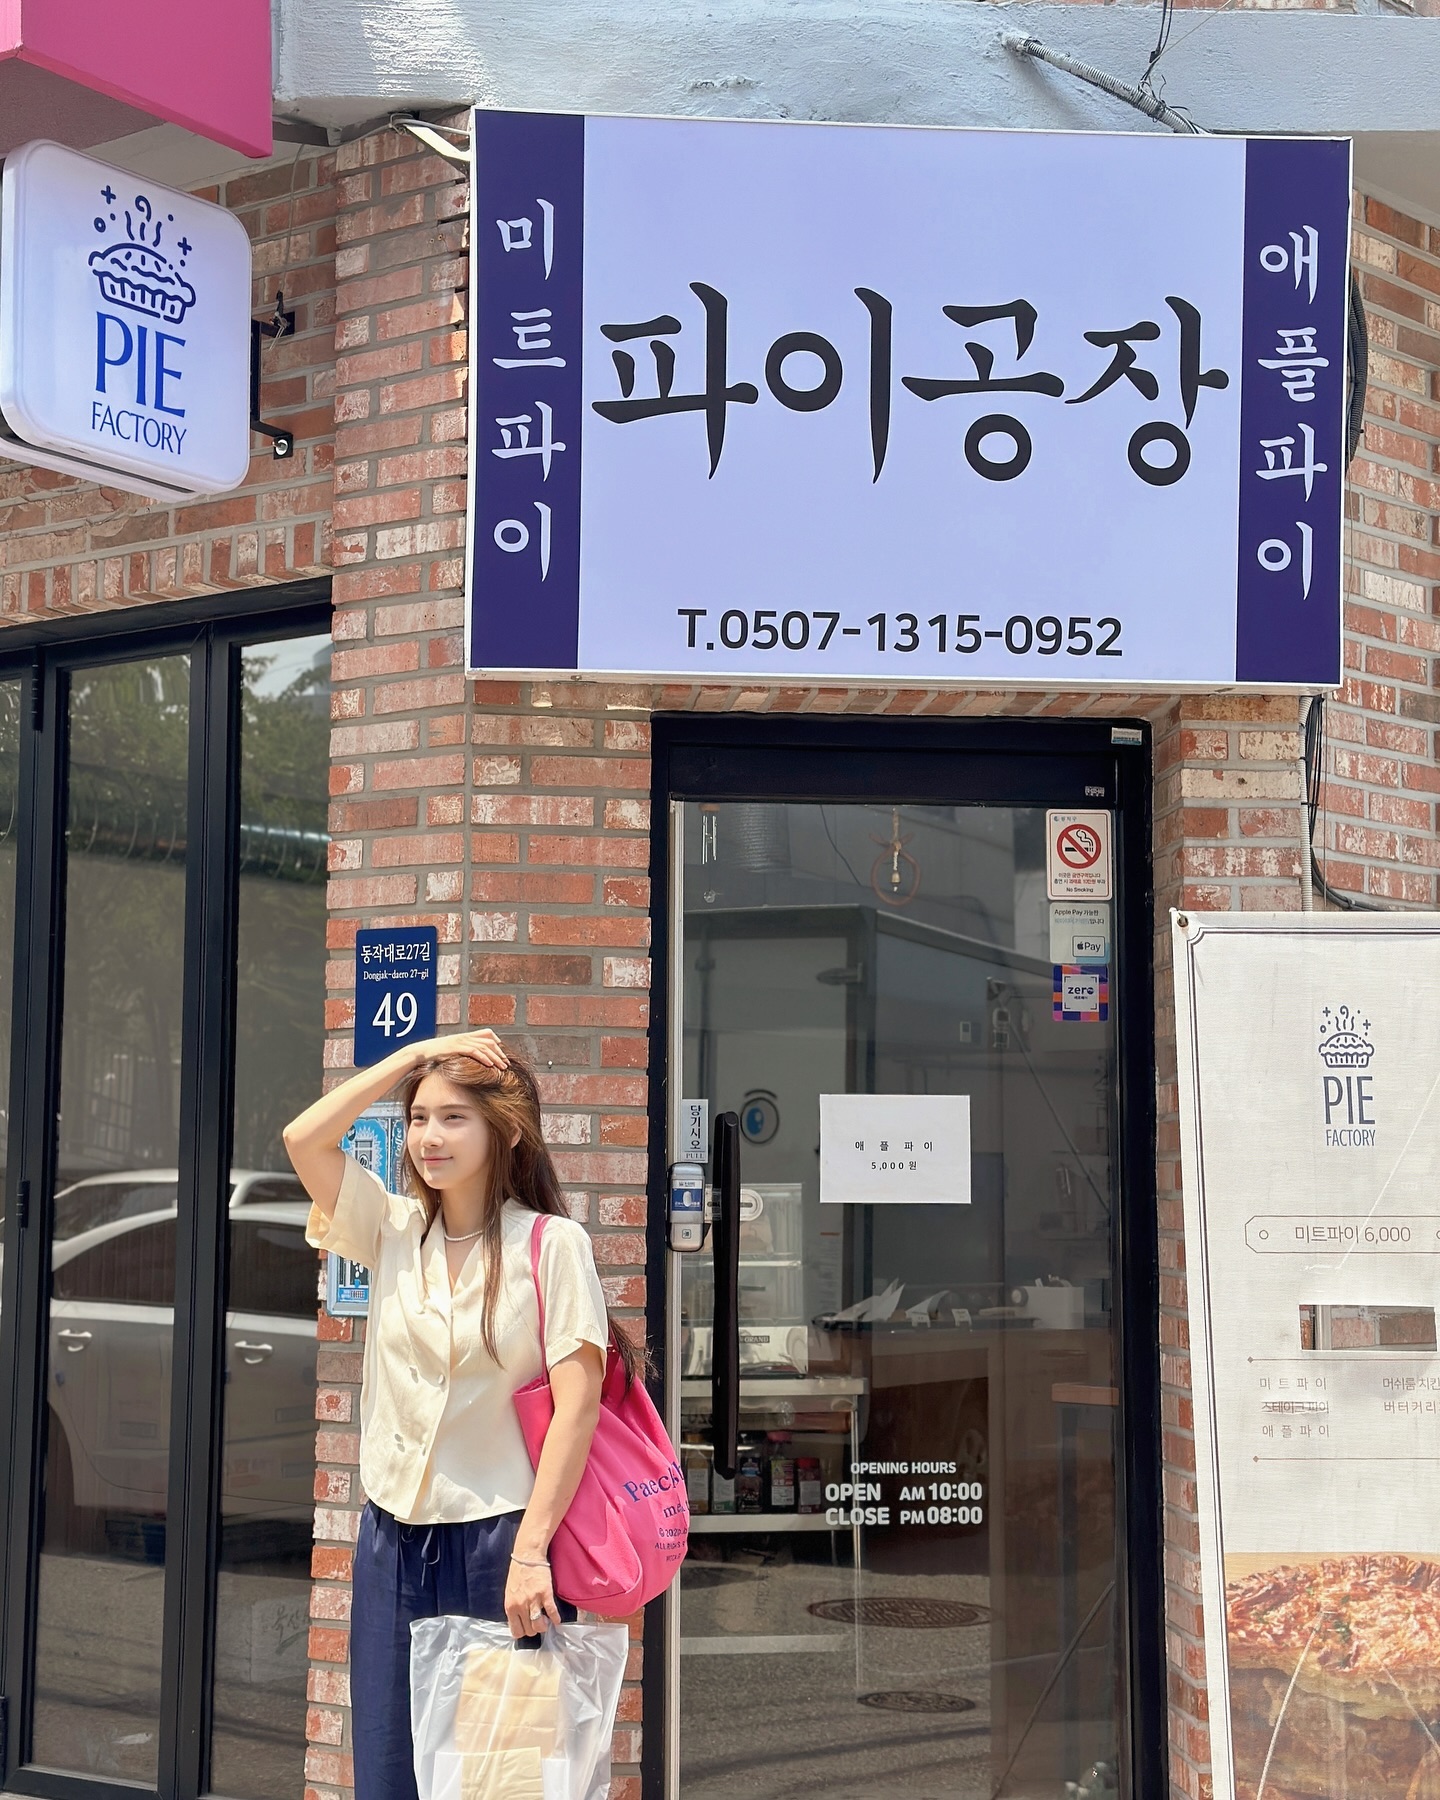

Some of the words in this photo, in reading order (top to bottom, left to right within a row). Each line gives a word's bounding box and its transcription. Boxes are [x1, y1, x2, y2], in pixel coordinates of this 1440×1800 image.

[95, 311, 187, 418] PIE
[491, 197, 567, 582] 미트파이
[591, 281, 1230, 487] 파이공장
[1255, 224, 1330, 601] 애플파이
[91, 401, 187, 455] FACTORY
[677, 607, 1124, 658] T.0507-1315-0952
[1072, 909, 1083, 917] Pay
[360, 941, 431, 964] 동작대로27길
[1084, 942, 1101, 953] Pay
[363, 970, 409, 982] Dongjak-daero
[410, 968, 429, 980] 27-gil
[1067, 986, 1095, 995] zero
[372, 992, 418, 1038] 49
[1322, 1075, 1376, 1125] PIE
[689, 1104, 702, 1150] 당기시오
[1325, 1129, 1376, 1147] FACTORY
[1295, 1225, 1360, 1244] 미트파이
[1364, 1226, 1411, 1245] 6,000
[1383, 1400, 1440, 1414] 버터커리
[850, 1461, 909, 1475] OPENING
[911, 1461, 957, 1474] HOURS
[825, 1482, 881, 1501] OPEN
[899, 1486, 926, 1501] AM
[928, 1482, 983, 1501] 10:00
[825, 1506, 890, 1525] CLOSE
[900, 1510, 925, 1525] PM
[927, 1506, 983, 1525] 08:00
